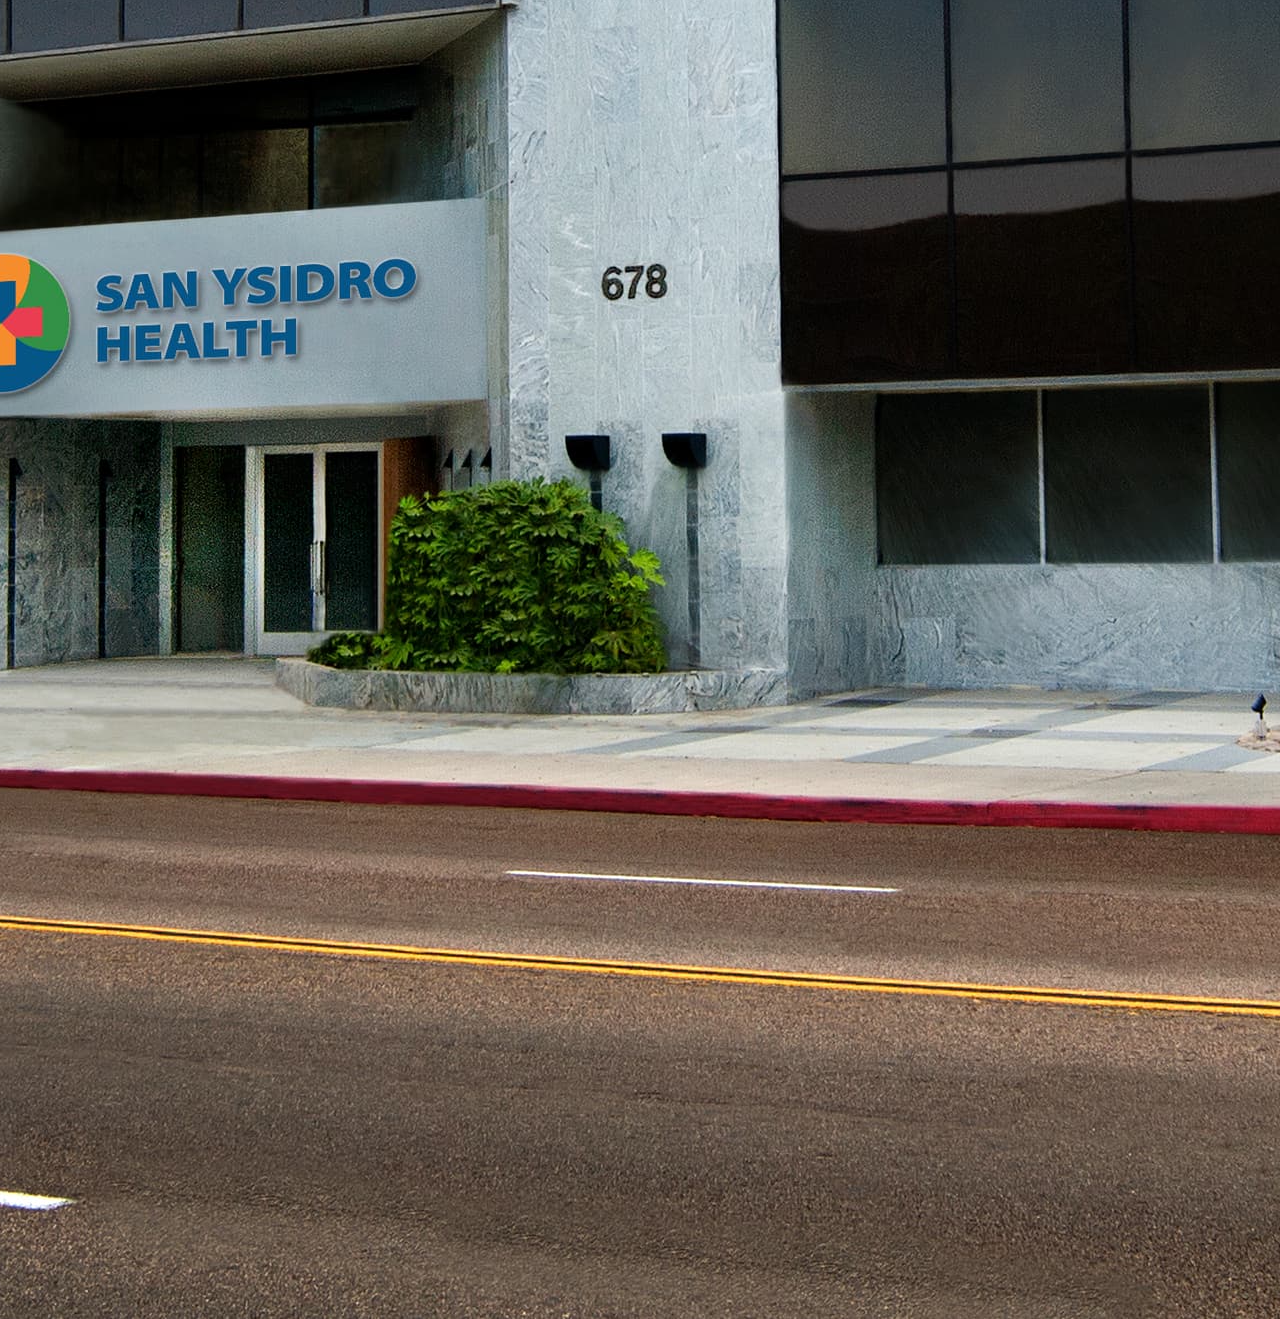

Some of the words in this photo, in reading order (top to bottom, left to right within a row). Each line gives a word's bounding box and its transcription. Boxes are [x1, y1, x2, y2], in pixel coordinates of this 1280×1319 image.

[96, 270, 198, 312] SAN
[212, 258, 417, 306] YSIDRO
[601, 263, 668, 301] 678
[96, 317, 297, 363] HEALTH
